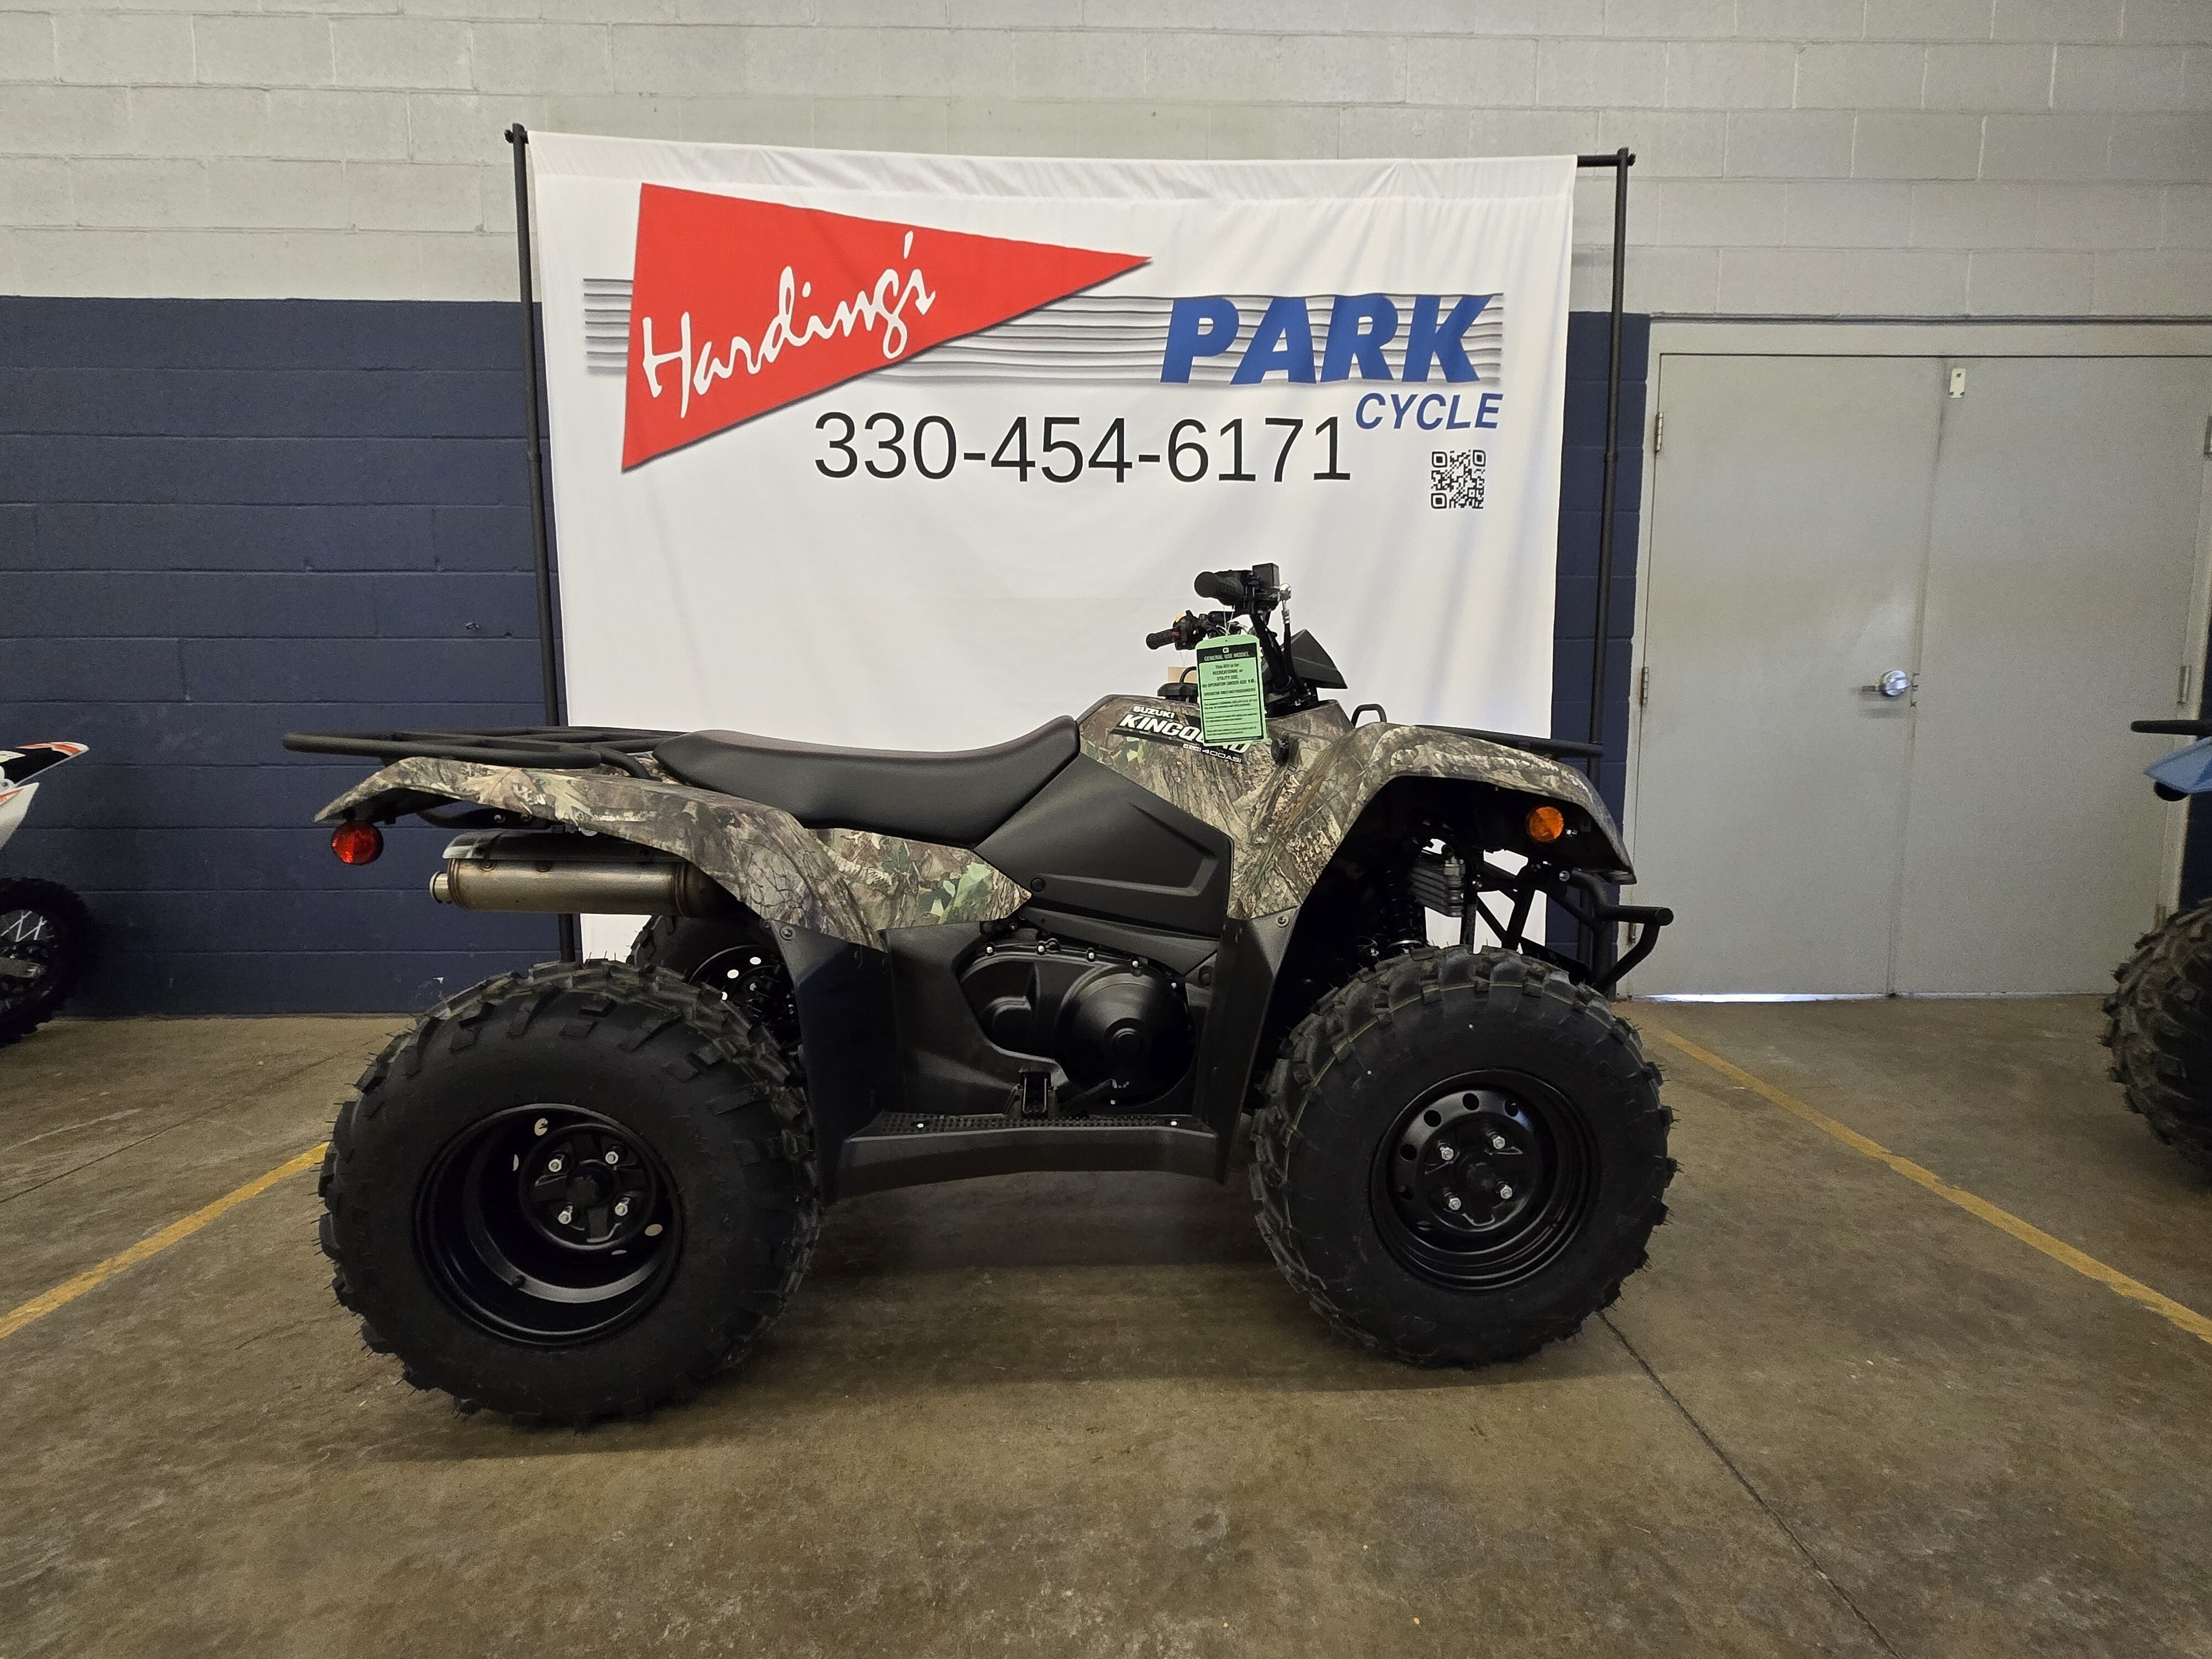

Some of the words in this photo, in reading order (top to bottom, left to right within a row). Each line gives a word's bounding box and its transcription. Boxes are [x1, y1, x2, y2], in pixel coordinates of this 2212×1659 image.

[643, 230, 936, 419] Harding's
[1162, 295, 1494, 384] PARK
[1355, 393, 1504, 430] CYCLE
[815, 412, 1351, 483] 330-454-6171
[1119, 713, 1251, 753] KINGQD
[1133, 706, 1175, 719] SUZUKI
